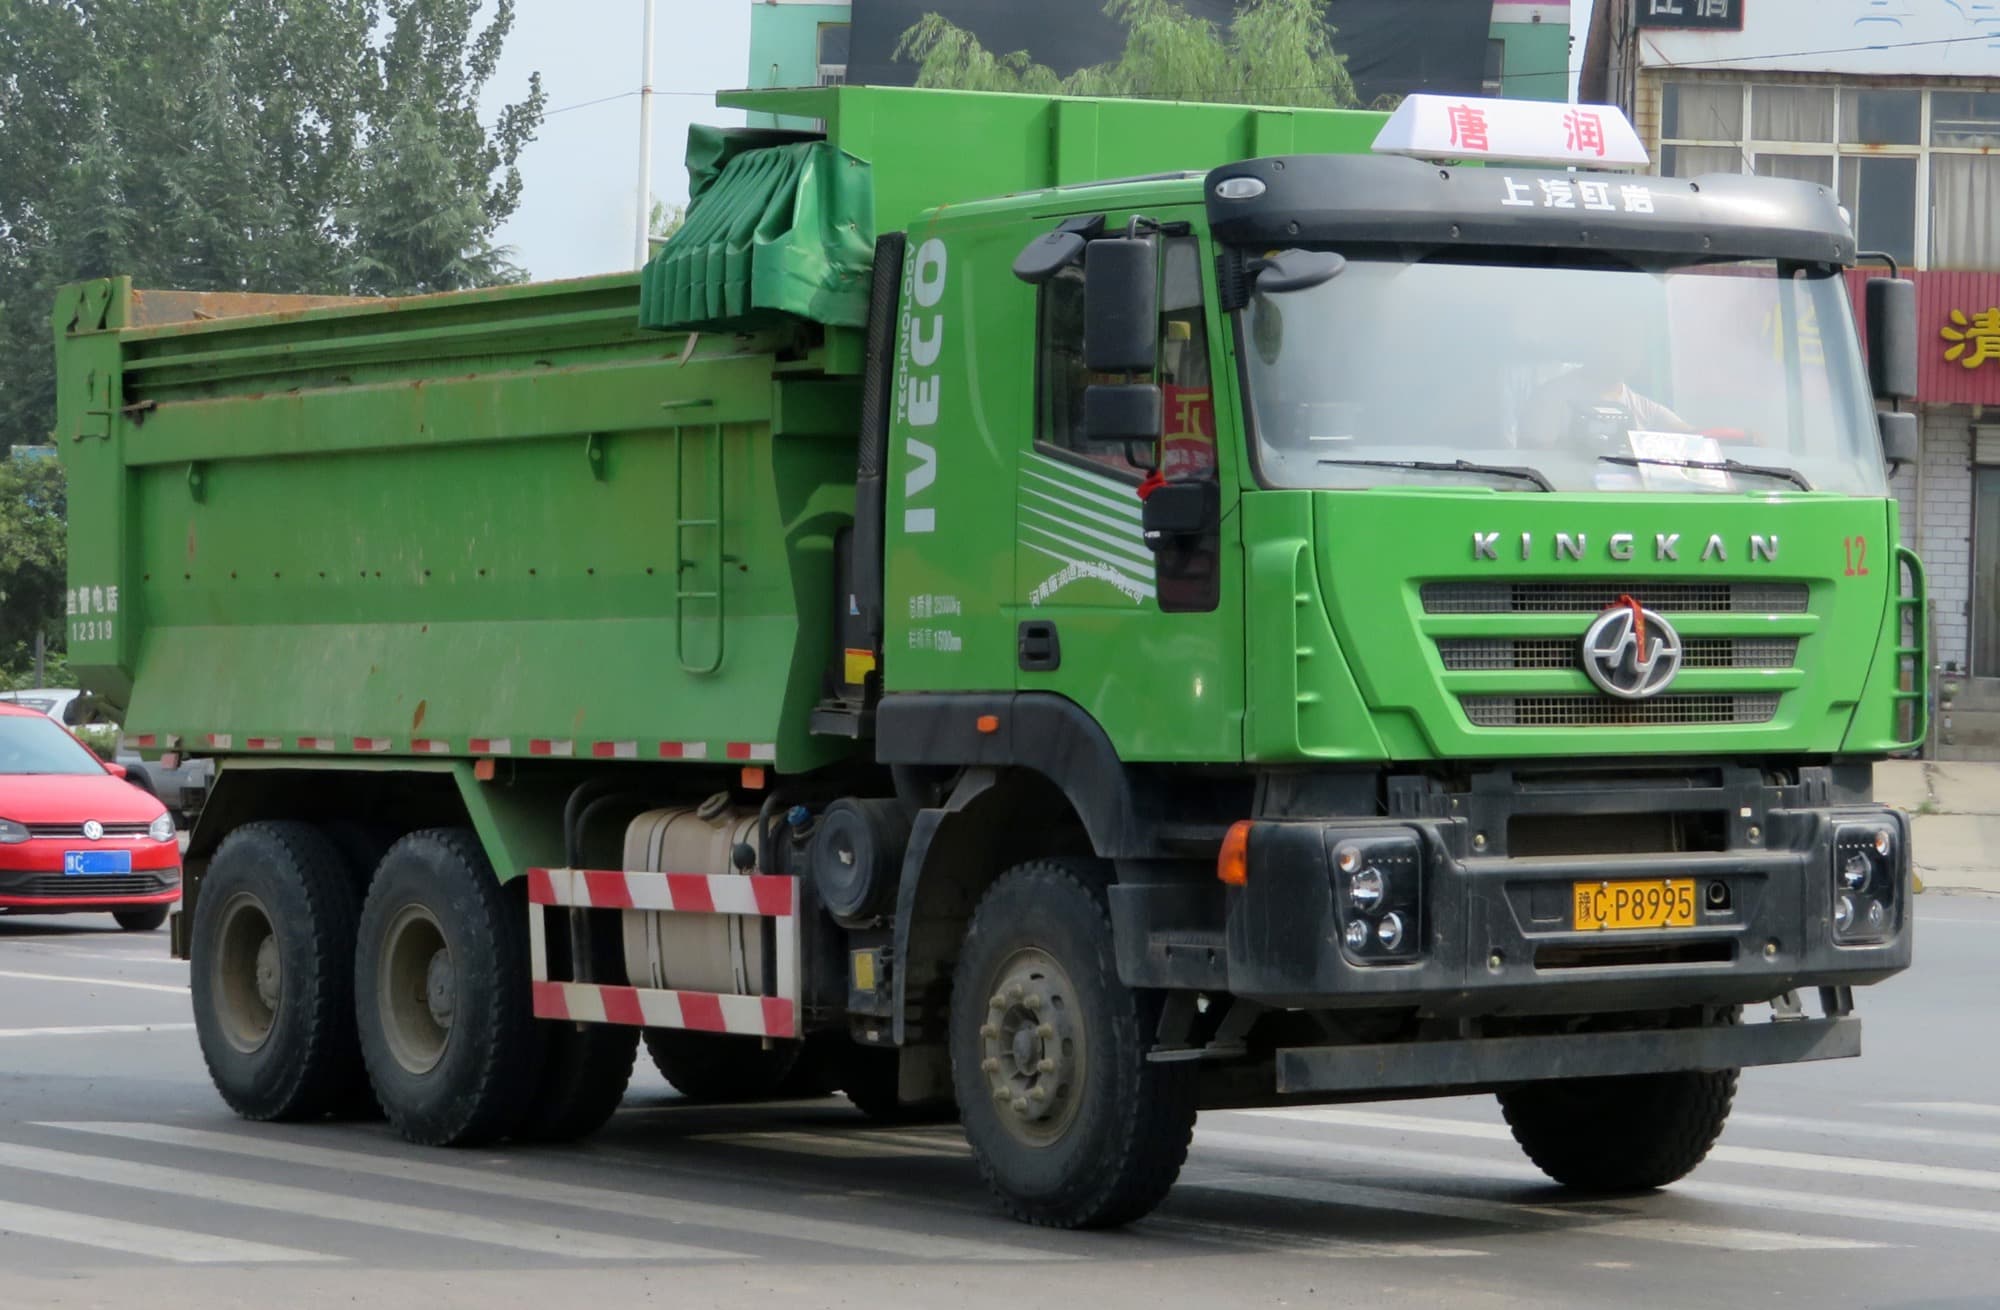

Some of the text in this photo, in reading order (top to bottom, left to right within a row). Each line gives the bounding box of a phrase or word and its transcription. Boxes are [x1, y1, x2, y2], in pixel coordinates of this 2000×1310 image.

[1447, 103, 1606, 157] 唐润
[1501, 176, 1655, 214] 上汽红岩
[897, 242, 916, 424] TECHNOLOGY
[904, 237, 948, 534] IVECO
[1473, 532, 1779, 562] KINGKAN
[1843, 535, 1870, 577] 12
[72, 620, 112, 641] 12319
